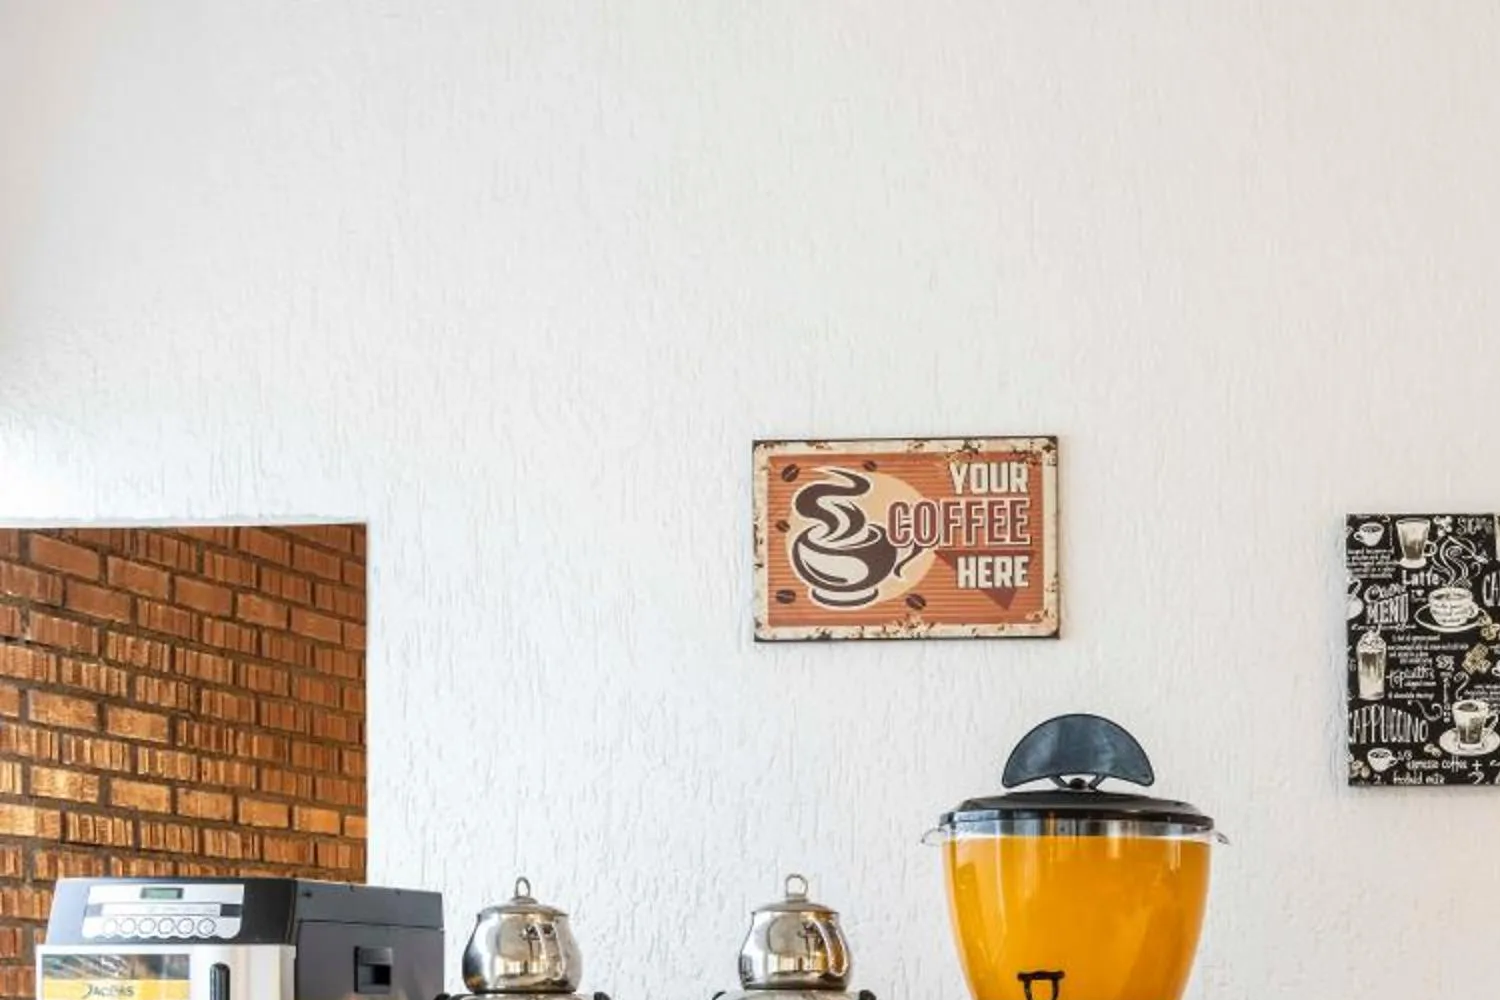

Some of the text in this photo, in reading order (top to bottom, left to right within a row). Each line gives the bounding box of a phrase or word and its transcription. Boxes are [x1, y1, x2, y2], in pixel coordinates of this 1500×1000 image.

[949, 461, 1028, 495] YOUR
[886, 498, 1032, 548] COFFEE
[957, 555, 1029, 589] HERE
[1402, 570, 1440, 586] Latte
[1366, 594, 1409, 624] MENU
